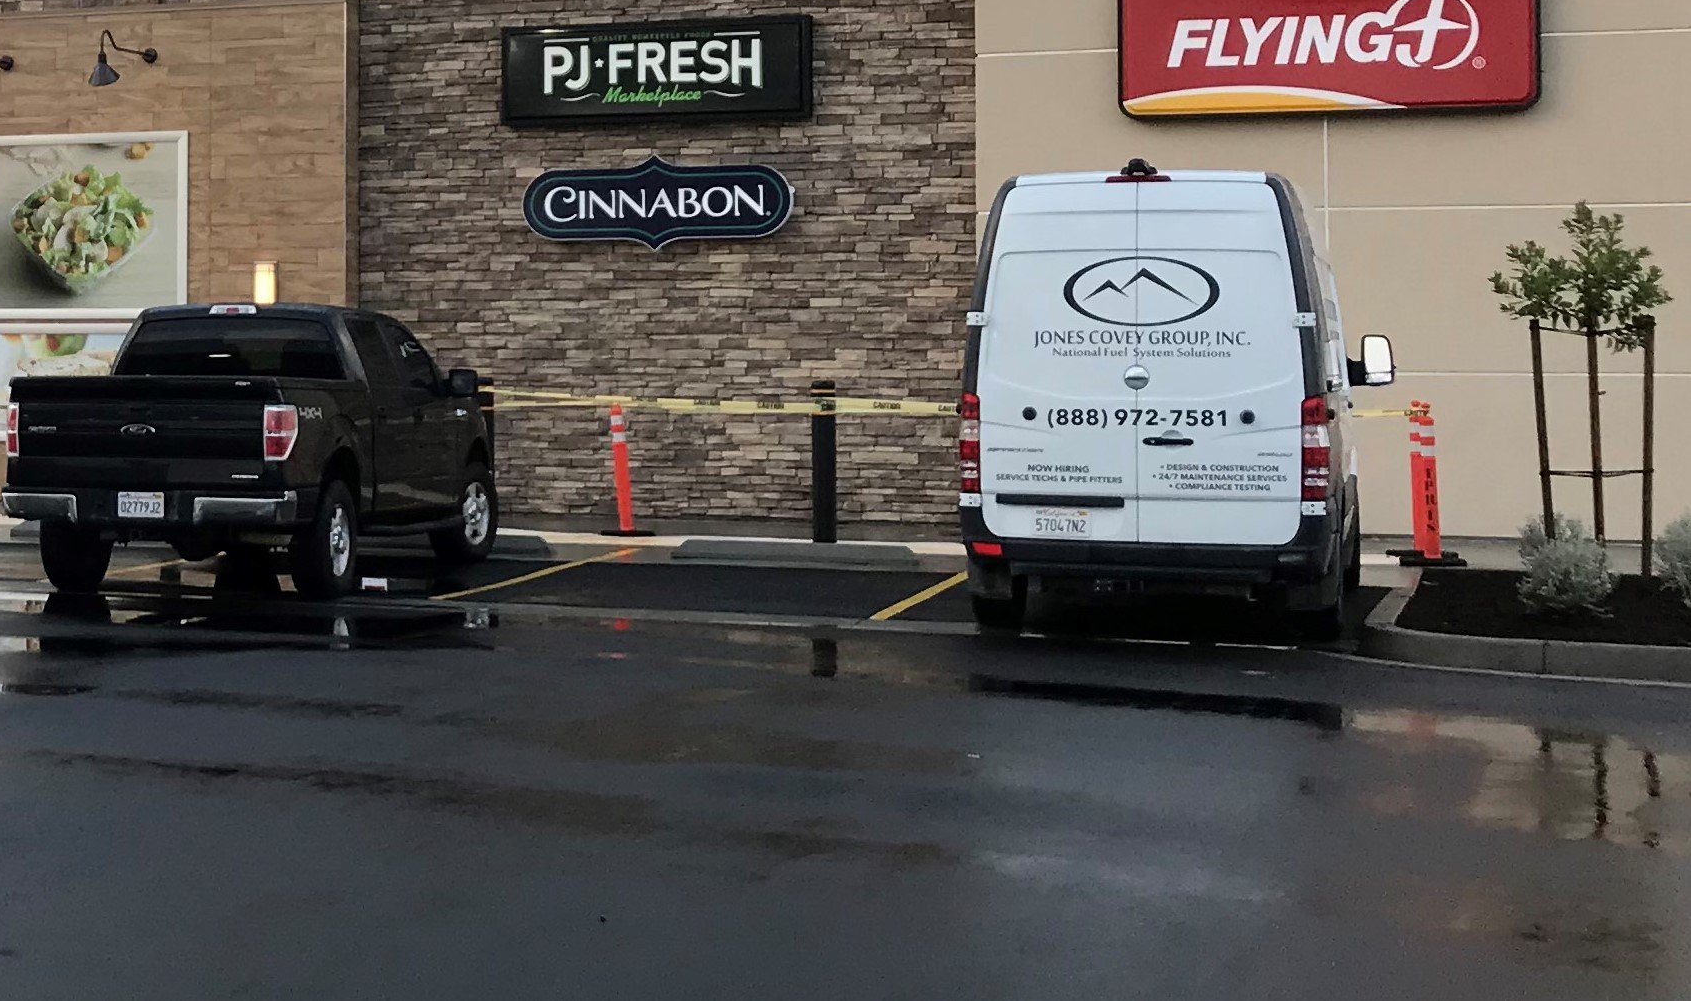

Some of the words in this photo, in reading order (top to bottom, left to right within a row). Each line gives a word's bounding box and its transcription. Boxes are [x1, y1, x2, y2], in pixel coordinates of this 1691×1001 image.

[609, 38, 763, 89] FRESH
[602, 83, 702, 107] Marketplace
[1034, 330, 1085, 348] JONES
[1089, 330, 1144, 345] COVEY
[1148, 330, 1211, 347] GROUP,
[1215, 331, 1251, 346] INC.
[1052, 347, 1101, 357] National
[1104, 347, 1128, 357] Fuel
[1133, 347, 1174, 359] System
[1176, 347, 1232, 358] Solutions
[938, 404, 957, 412] CAUT
[1047, 408, 1108, 428] (888)
[1114, 408, 1227, 427] 972-7581
[1027, 464, 1053, 472] NOW
[1055, 465, 1090, 474] HIRING
[1210, 464, 1279, 473] CONSTRUCTION
[996, 473, 1029, 481] SERVICE
[1031, 474, 1058, 482] TECHS
[1068, 475, 1087, 483] PIPE
[1089, 476, 1123, 484] FITTERS
[1180, 474, 1244, 482] MAINTENANCE
[1247, 474, 1288, 482] SERVICES
[1174, 483, 1232, 491] COMPLIANCE
[1235, 483, 1271, 491] TESTING
[120, 501, 161, 514] 02779J2
